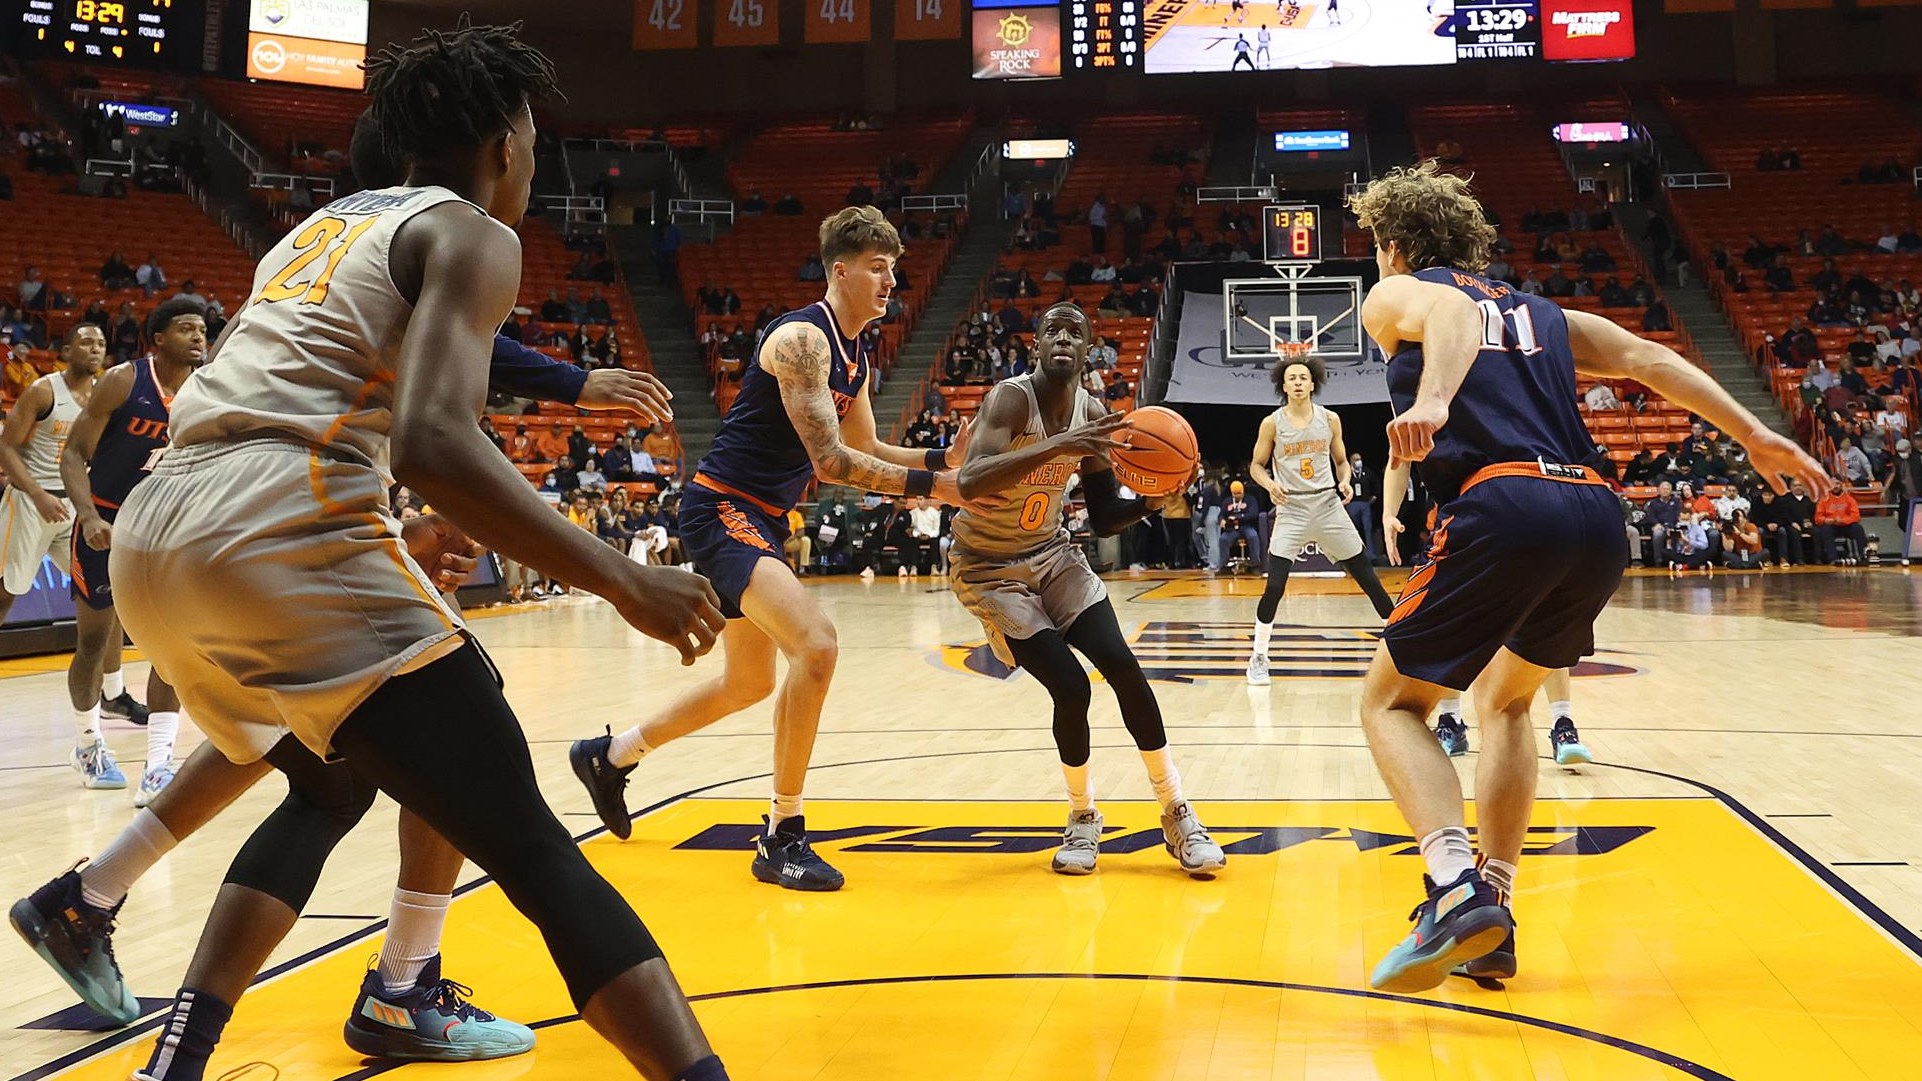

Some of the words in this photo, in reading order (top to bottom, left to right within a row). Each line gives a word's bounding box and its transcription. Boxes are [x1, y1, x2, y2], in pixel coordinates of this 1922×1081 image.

[23, 13, 50, 25] FOULS
[76, 0, 124, 23] 13:29
[648, 0, 682, 30] 42
[728, 0, 763, 28] 45
[820, 0, 854, 24] 44
[1466, 9, 1527, 31] 13:29
[1552, 11, 1621, 25] MATTRESS
[138, 27, 165, 39] FOULS
[990, 49, 1041, 60] SPEAKING
[1000, 59, 1031, 75] ROCK
[125, 109, 166, 122] WestStar
[1293, 228, 1309, 255] 8
[253, 213, 382, 306] 21
[1477, 299, 1543, 356] 11
[1299, 457, 1315, 480] 5
[1019, 491, 1050, 532] 0
